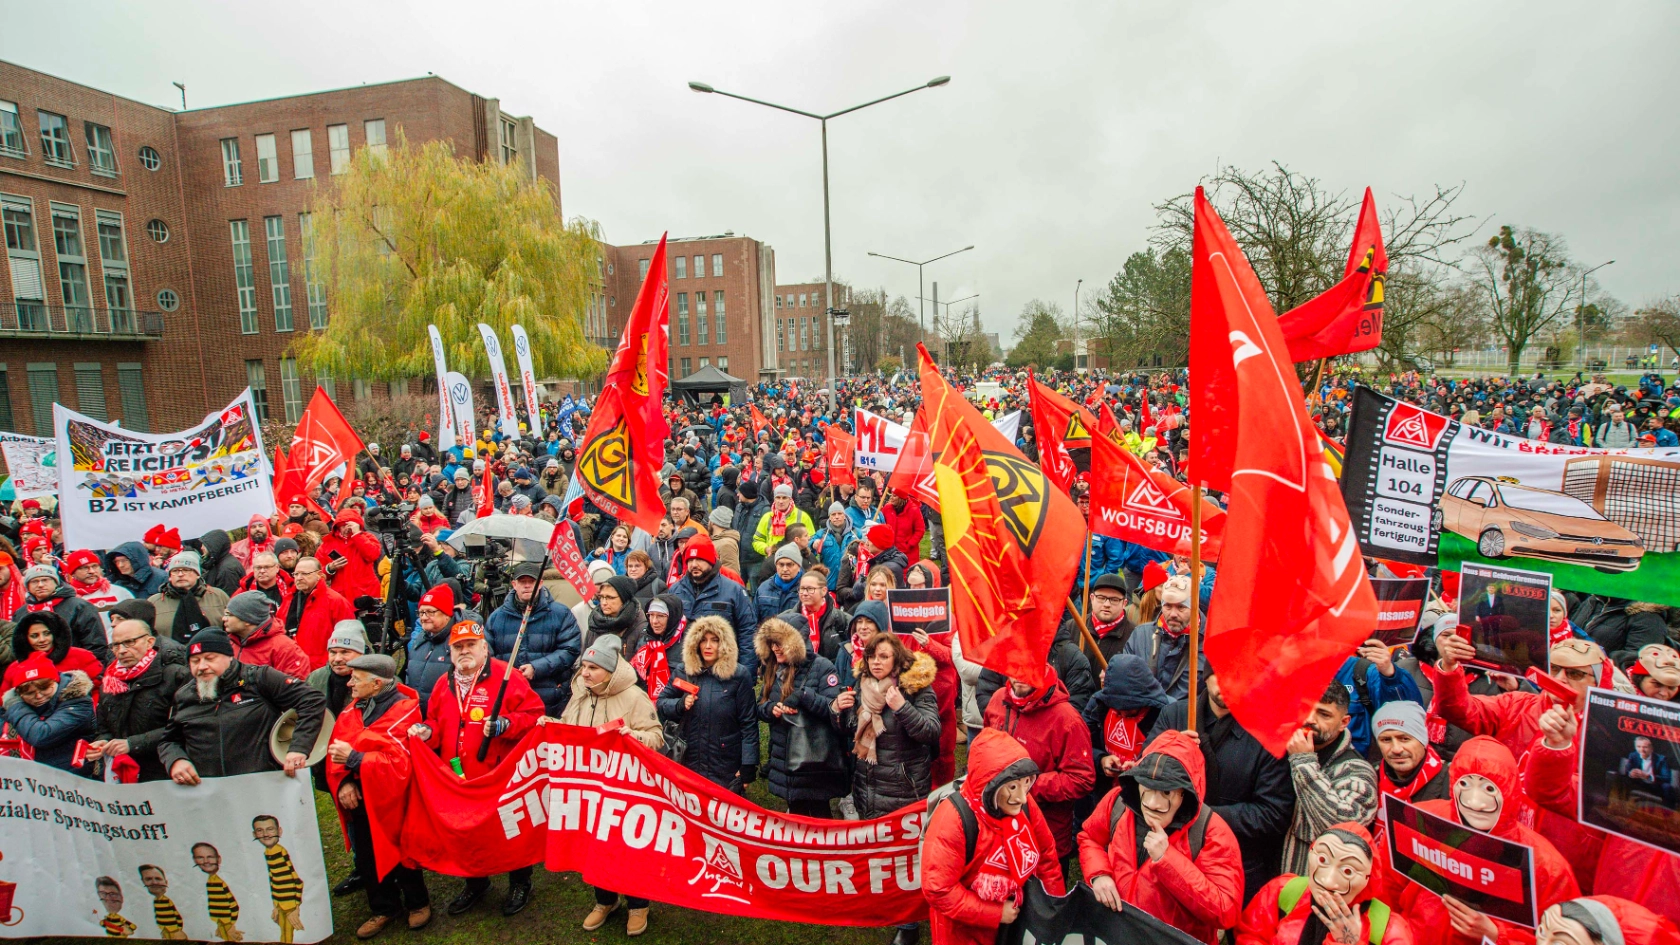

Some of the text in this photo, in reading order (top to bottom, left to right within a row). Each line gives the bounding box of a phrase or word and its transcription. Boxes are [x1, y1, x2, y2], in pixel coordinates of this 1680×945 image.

[104, 443, 156, 457] JETZT
[860, 455, 876, 466] B14
[1382, 453, 1431, 474] Halle
[89, 478, 259, 513] B2 IST KAMPFBEREIT!
[1388, 478, 1422, 496] 104
[1377, 503, 1420, 518] Sonder-
[1100, 506, 1208, 544] WOLFSBURG
[1374, 528, 1425, 546] fertigung
[1375, 516, 1428, 534] fahrzeug-
[552, 545, 588, 596] RECHTS
[557, 534, 591, 583] GEGEN
[1463, 567, 1478, 576] Haus
[1479, 569, 1491, 577] des
[893, 605, 945, 618] Dieselgate
[1590, 694, 1680, 722] Haus des Geldver
[25, 777, 105, 813] Vorhaben
[107, 800, 155, 816] sind
[53, 808, 169, 841] Sprengstoff!
[596, 798, 686, 858] FOR
[756, 854, 858, 894] OUR
[1412, 837, 1473, 880] Indien
